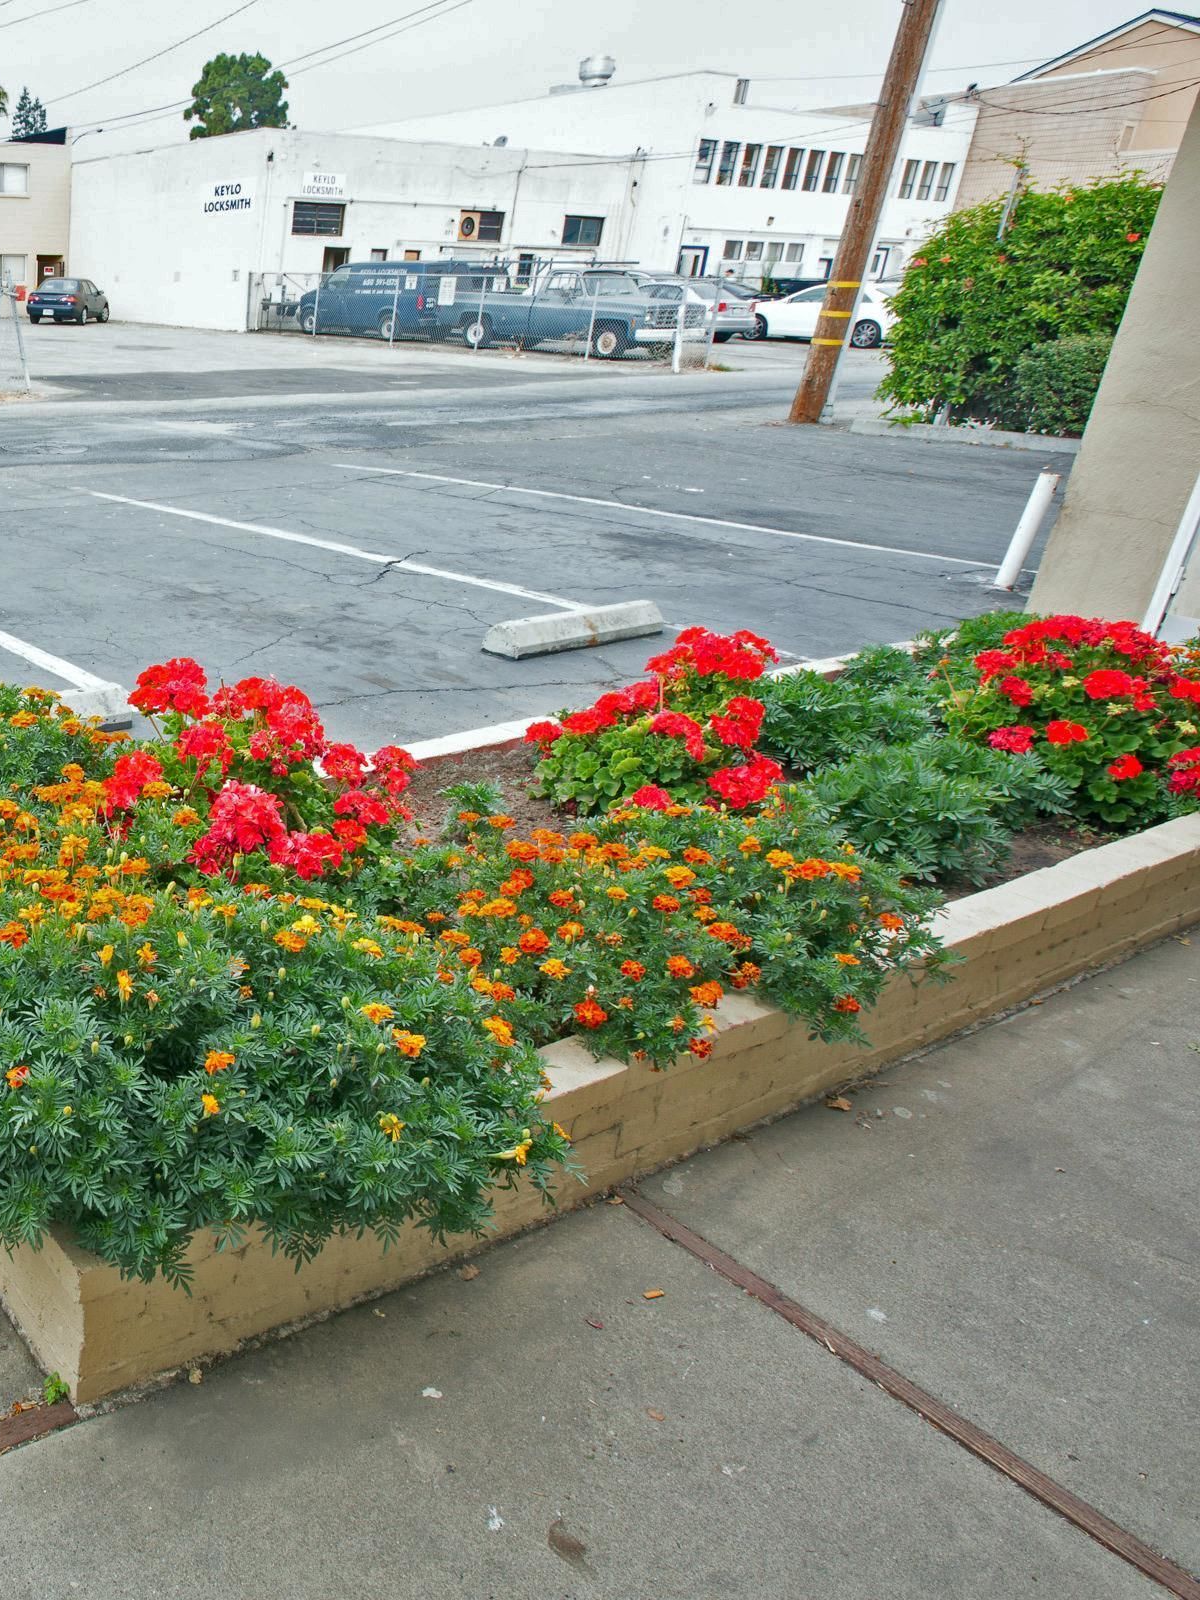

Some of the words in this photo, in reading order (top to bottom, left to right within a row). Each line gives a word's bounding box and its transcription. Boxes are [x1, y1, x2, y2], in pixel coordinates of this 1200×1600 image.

[313, 175, 336, 184] KEYLO
[214, 183, 242, 196] KEYLO
[302, 185, 344, 196] LOCKSMITH
[204, 198, 251, 212] LOCKSMITH
